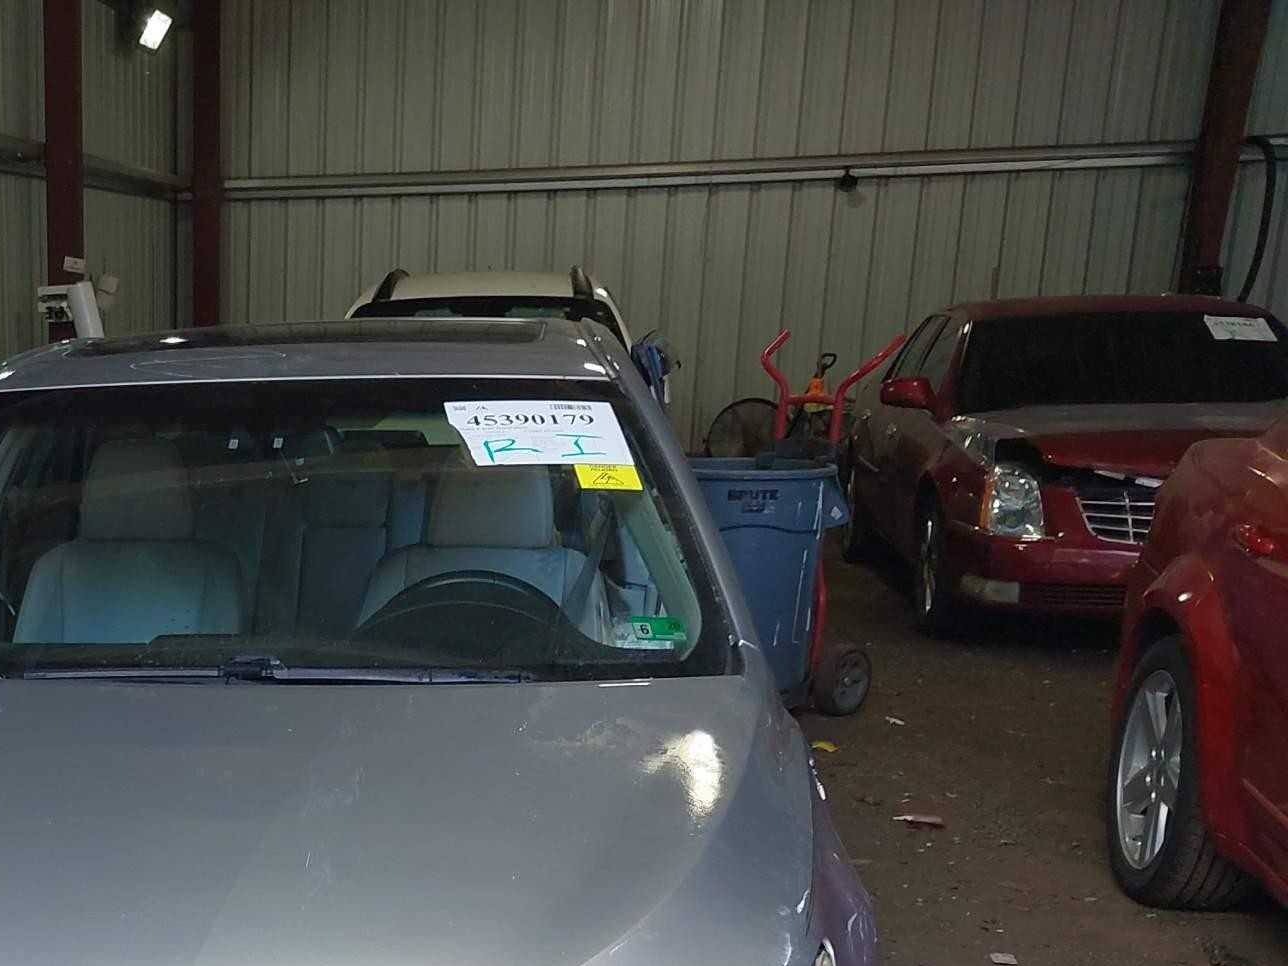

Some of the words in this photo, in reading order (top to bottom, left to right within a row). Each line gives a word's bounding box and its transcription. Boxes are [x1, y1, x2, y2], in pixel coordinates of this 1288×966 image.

[466, 413, 594, 427] 45390179
[483, 438, 543, 463] R
[639, 623, 650, 635] 6
